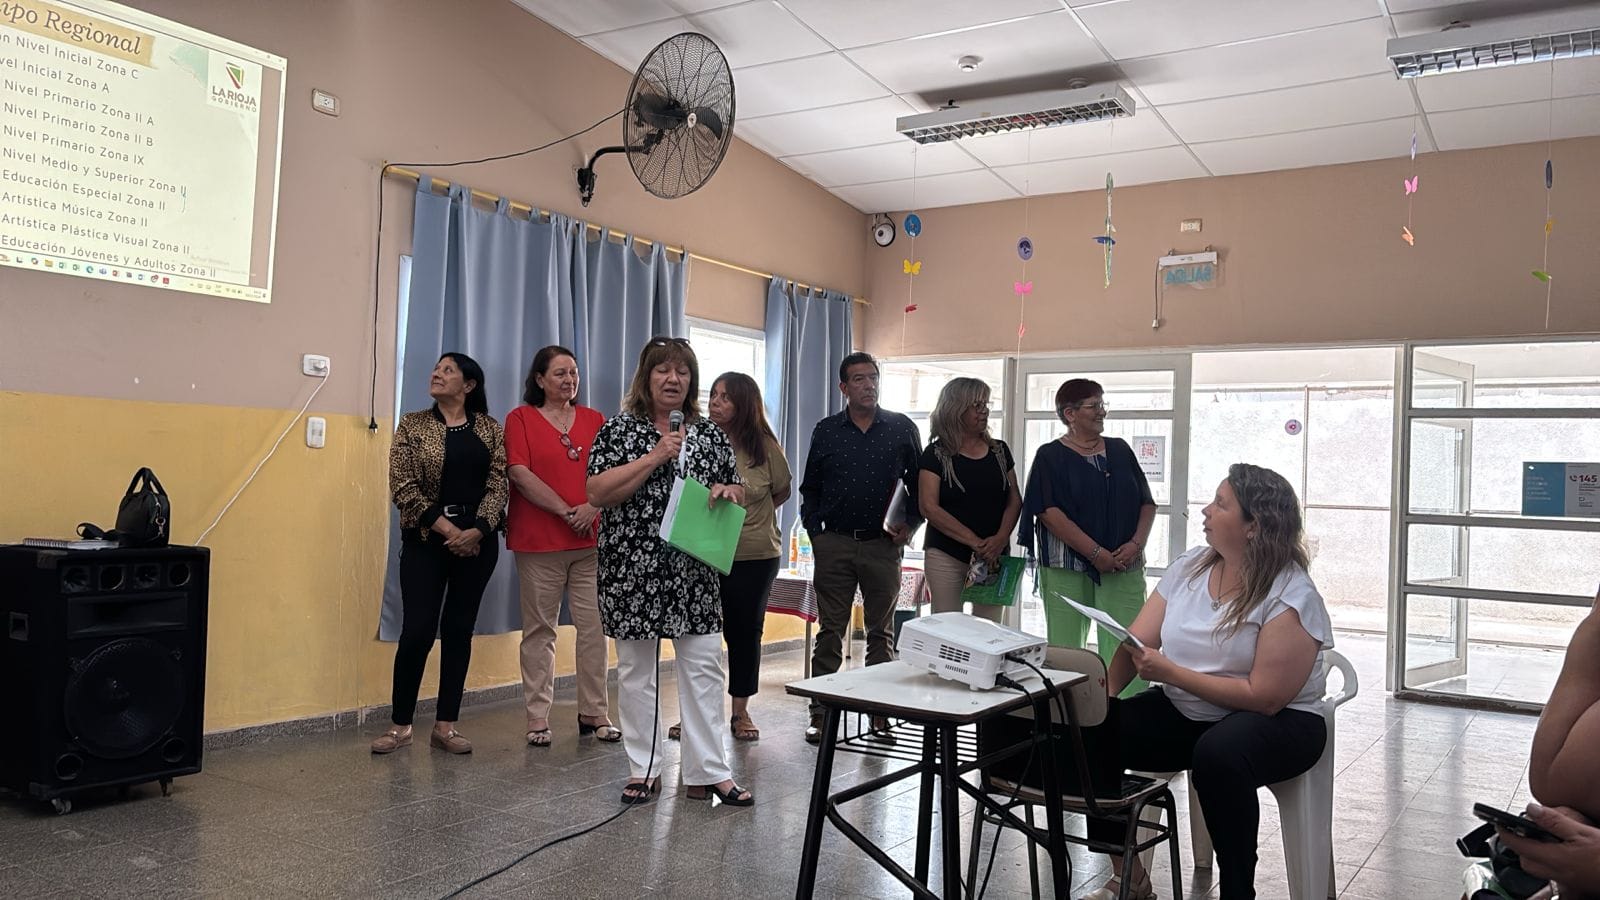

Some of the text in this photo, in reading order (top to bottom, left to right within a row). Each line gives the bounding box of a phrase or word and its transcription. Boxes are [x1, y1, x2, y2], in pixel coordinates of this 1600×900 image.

[0, 1, 141, 55] ipo Regional
[16, 36, 49, 54] Nivel
[55, 47, 91, 66] Inicial
[97, 59, 127, 77] Zona
[131, 69, 139, 79] C
[23, 60, 61, 80] Inicial
[66, 73, 97, 90] Zona
[101, 82, 110, 94] A
[5, 79, 154, 127] Nivel Primario Zona II A
[4, 102, 153, 147] Nivel Primario Zona II B
[4, 124, 144, 165] Nivel Primario Zona IX
[3, 147, 36, 163] Nivel
[42, 155, 78, 172] Medio
[83, 165, 90, 176] y
[95, 167, 144, 186] Superior
[148, 178, 176, 193] Zona
[3, 169, 165, 211] Educación Especial Zona II
[2, 192, 147, 227] Artística Música Zona II
[1, 214, 190, 254] Artística Plástica Visual Zona II
[1, 235, 66, 254] Educación
[71, 245, 119, 262] Jóvenes
[124, 256, 130, 265] y
[134, 257, 176, 271] Adultos
[180, 263, 206, 276] Zona
[210, 267, 216, 278] II
[1579, 474, 1598, 483] 145
